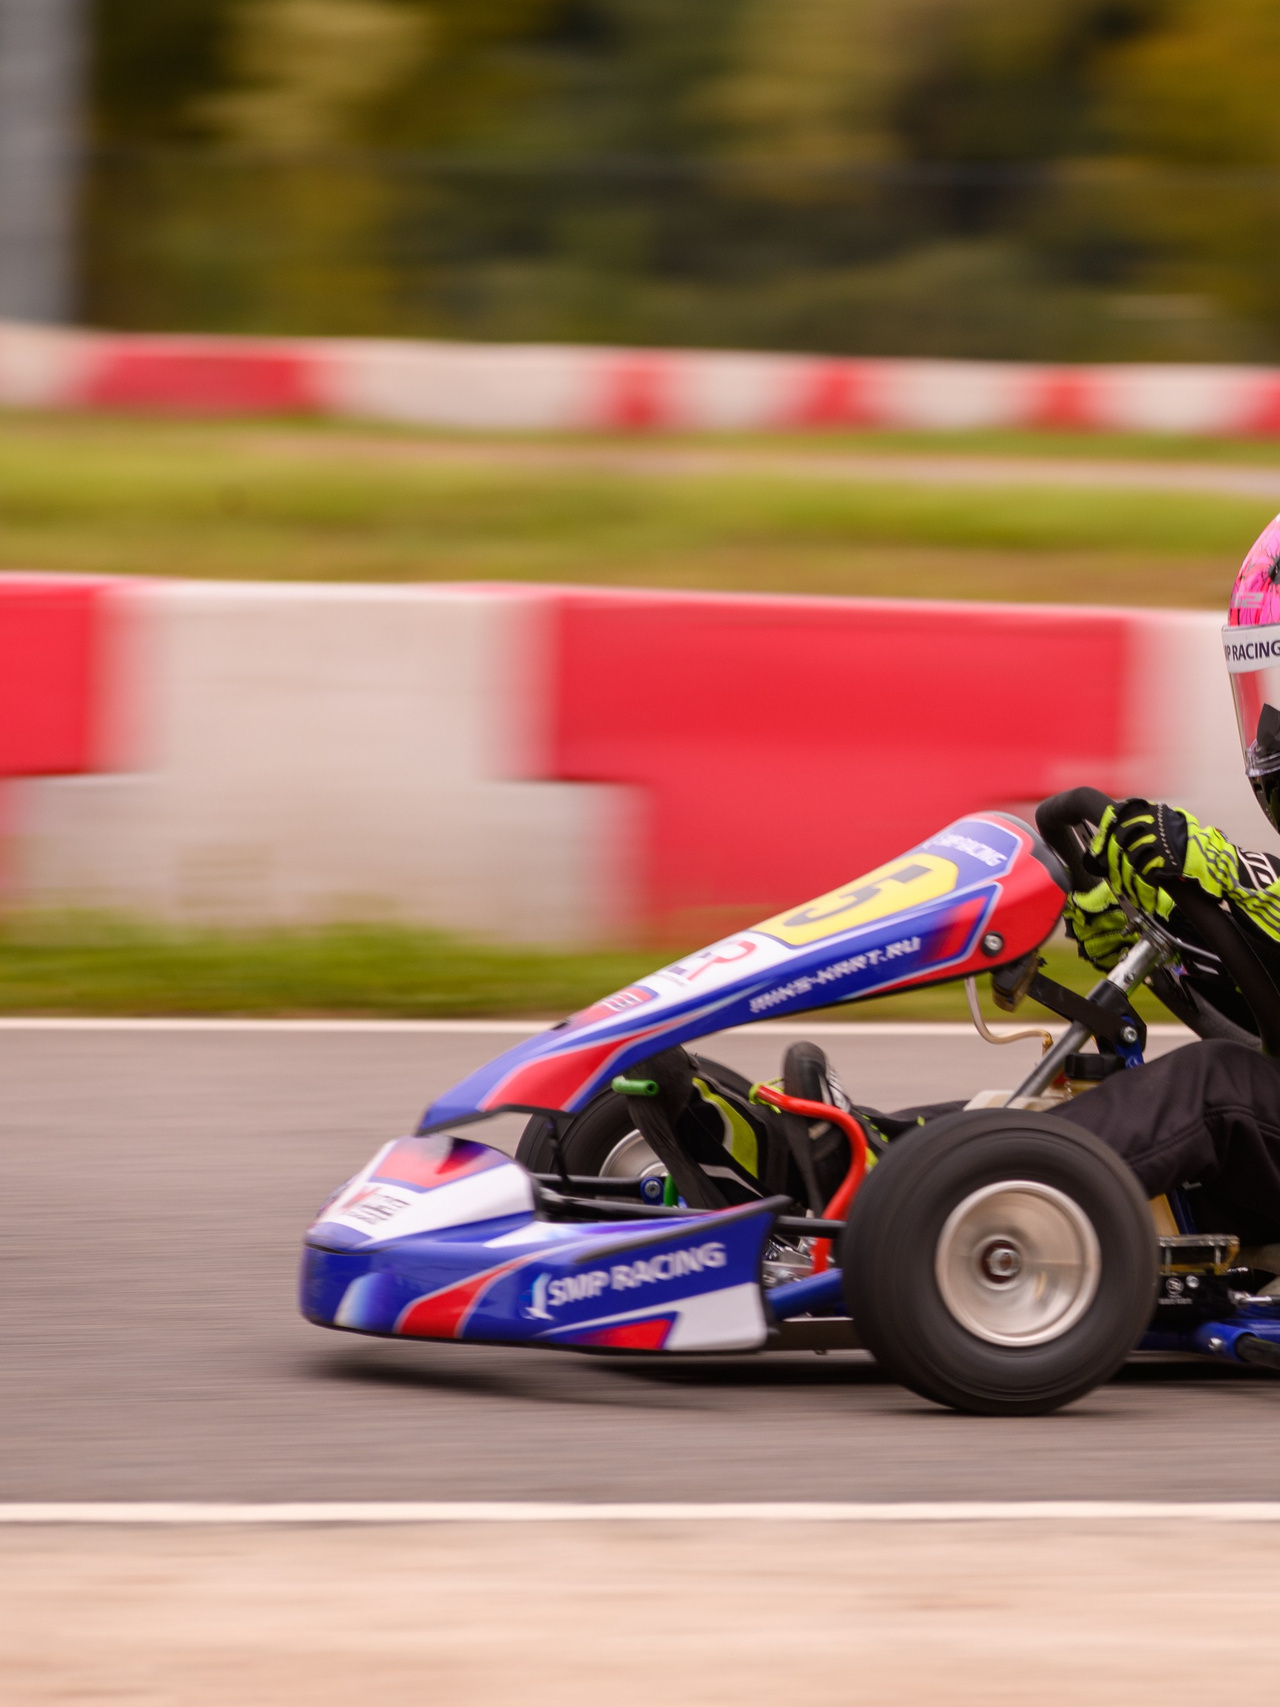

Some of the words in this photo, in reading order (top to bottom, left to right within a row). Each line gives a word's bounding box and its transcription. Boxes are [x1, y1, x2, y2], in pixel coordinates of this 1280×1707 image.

[783, 863, 933, 927] 5
[547, 1270, 610, 1306] SMP
[610, 1241, 727, 1291] RACING
